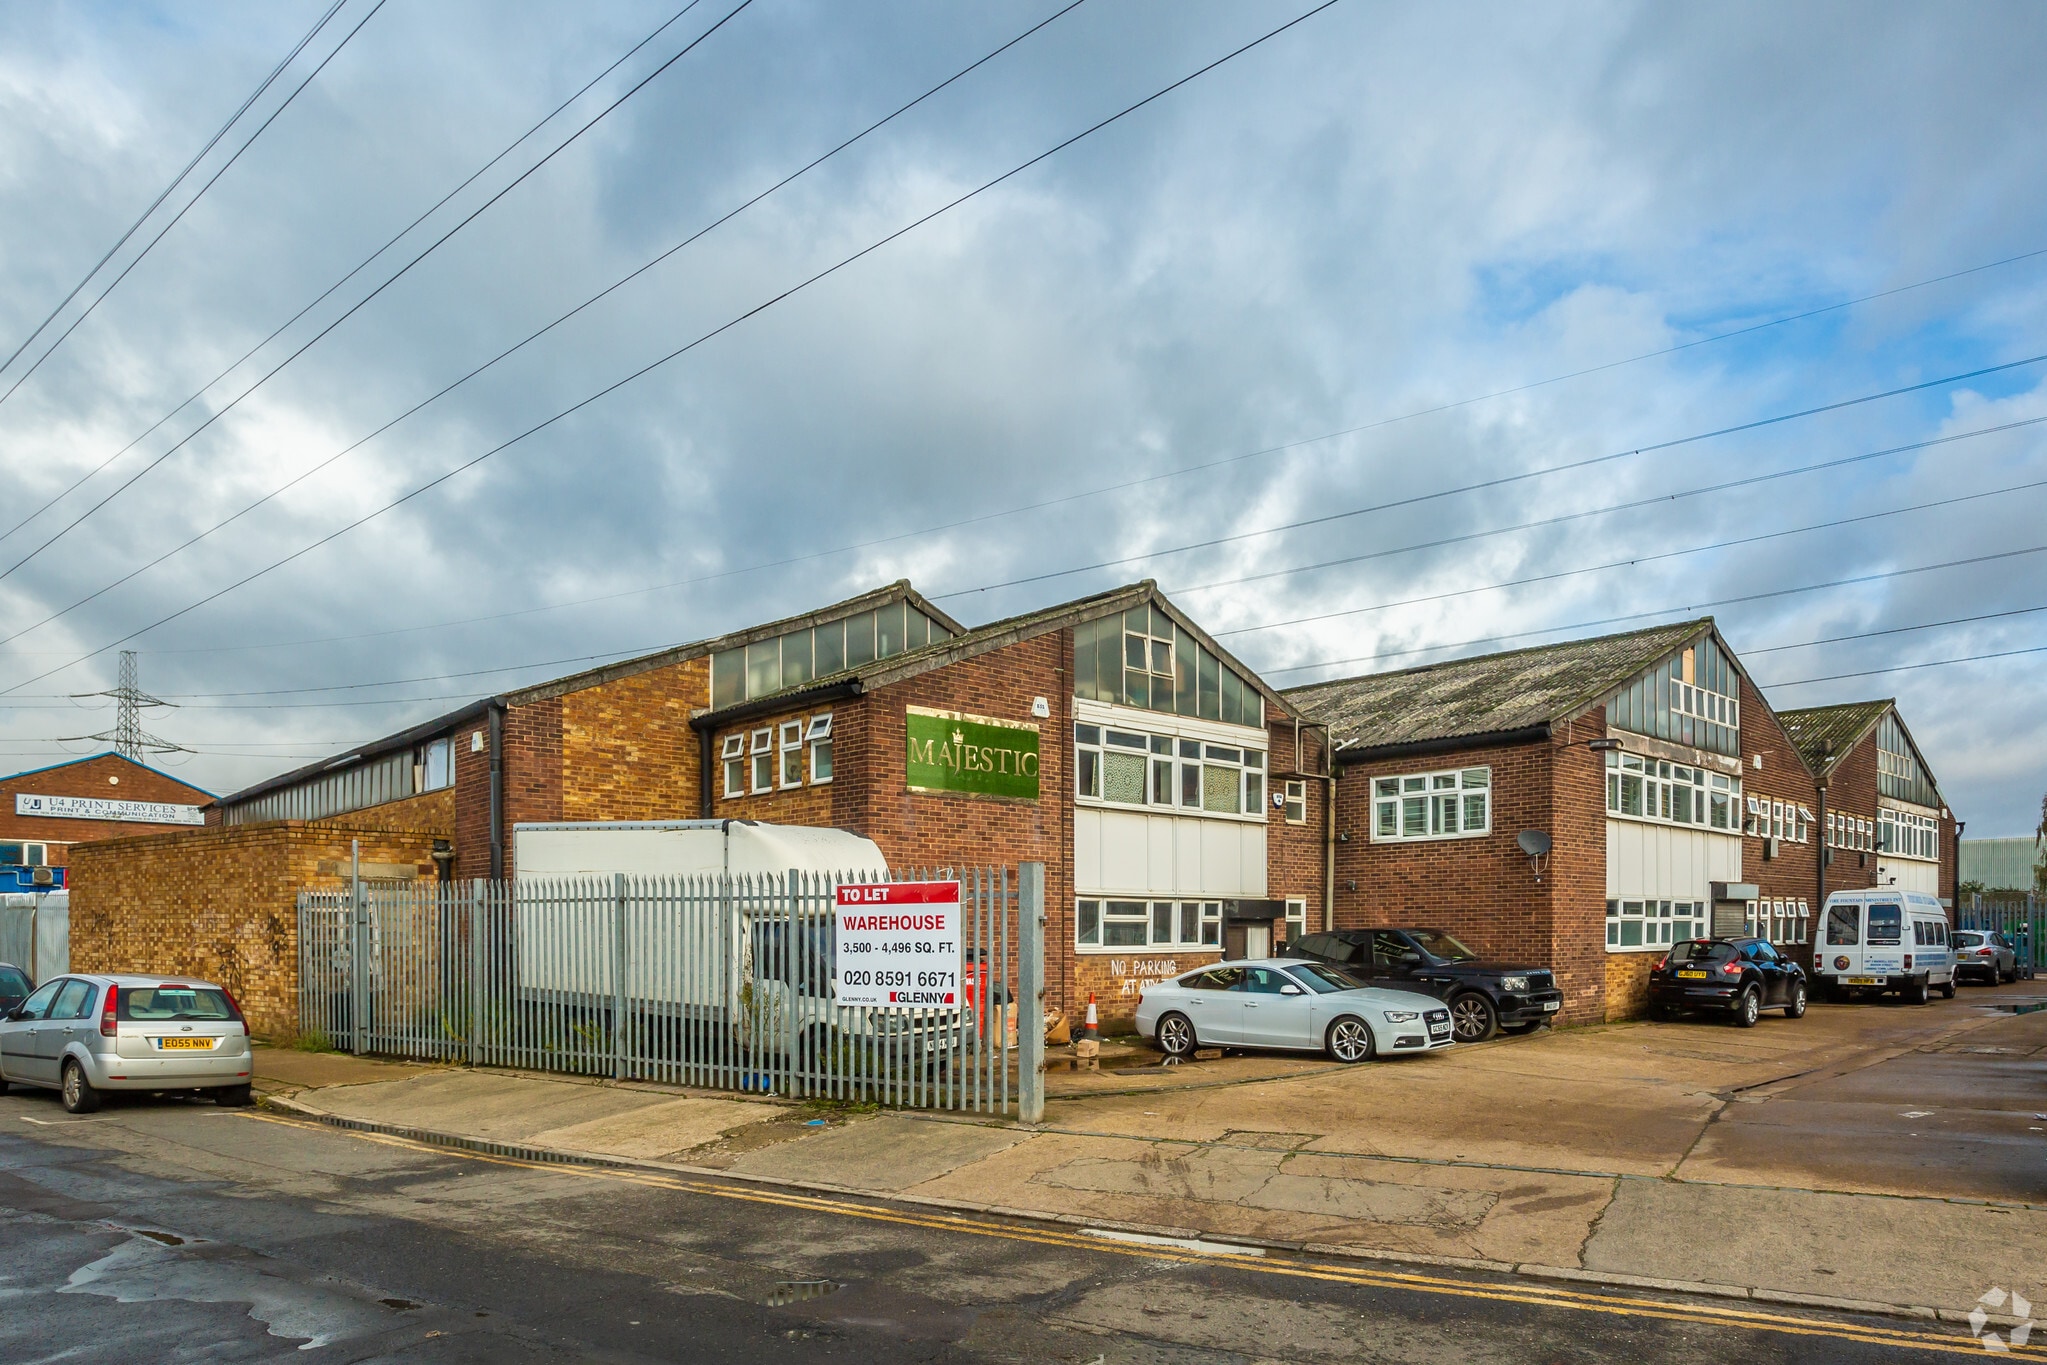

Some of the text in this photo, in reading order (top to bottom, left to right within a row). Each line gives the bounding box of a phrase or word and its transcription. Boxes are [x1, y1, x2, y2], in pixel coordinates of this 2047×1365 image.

[909, 737, 1038, 777] MAJESTIC
[49, 798, 65, 807] U4
[71, 799, 113, 809] PRINT
[118, 802, 176, 813] SERVICES
[95, 809, 175, 819] COMMUNICATION
[842, 888, 889, 902] TO LET
[843, 915, 945, 930] WAREHOUSE
[843, 942, 872, 955] 3,500
[881, 942, 911, 955] 4,496
[914, 942, 935, 953] SQ.
[939, 942, 955, 953] FT.
[1111, 959, 1177, 976] NO PARKING
[844, 970, 871, 986] 020
[875, 971, 911, 986] 8591
[918, 971, 955, 987] 6671
[1121, 978, 1137, 995] AT
[897, 992, 945, 1003] GLENNY
[193, 1039, 211, 1047] NNV
